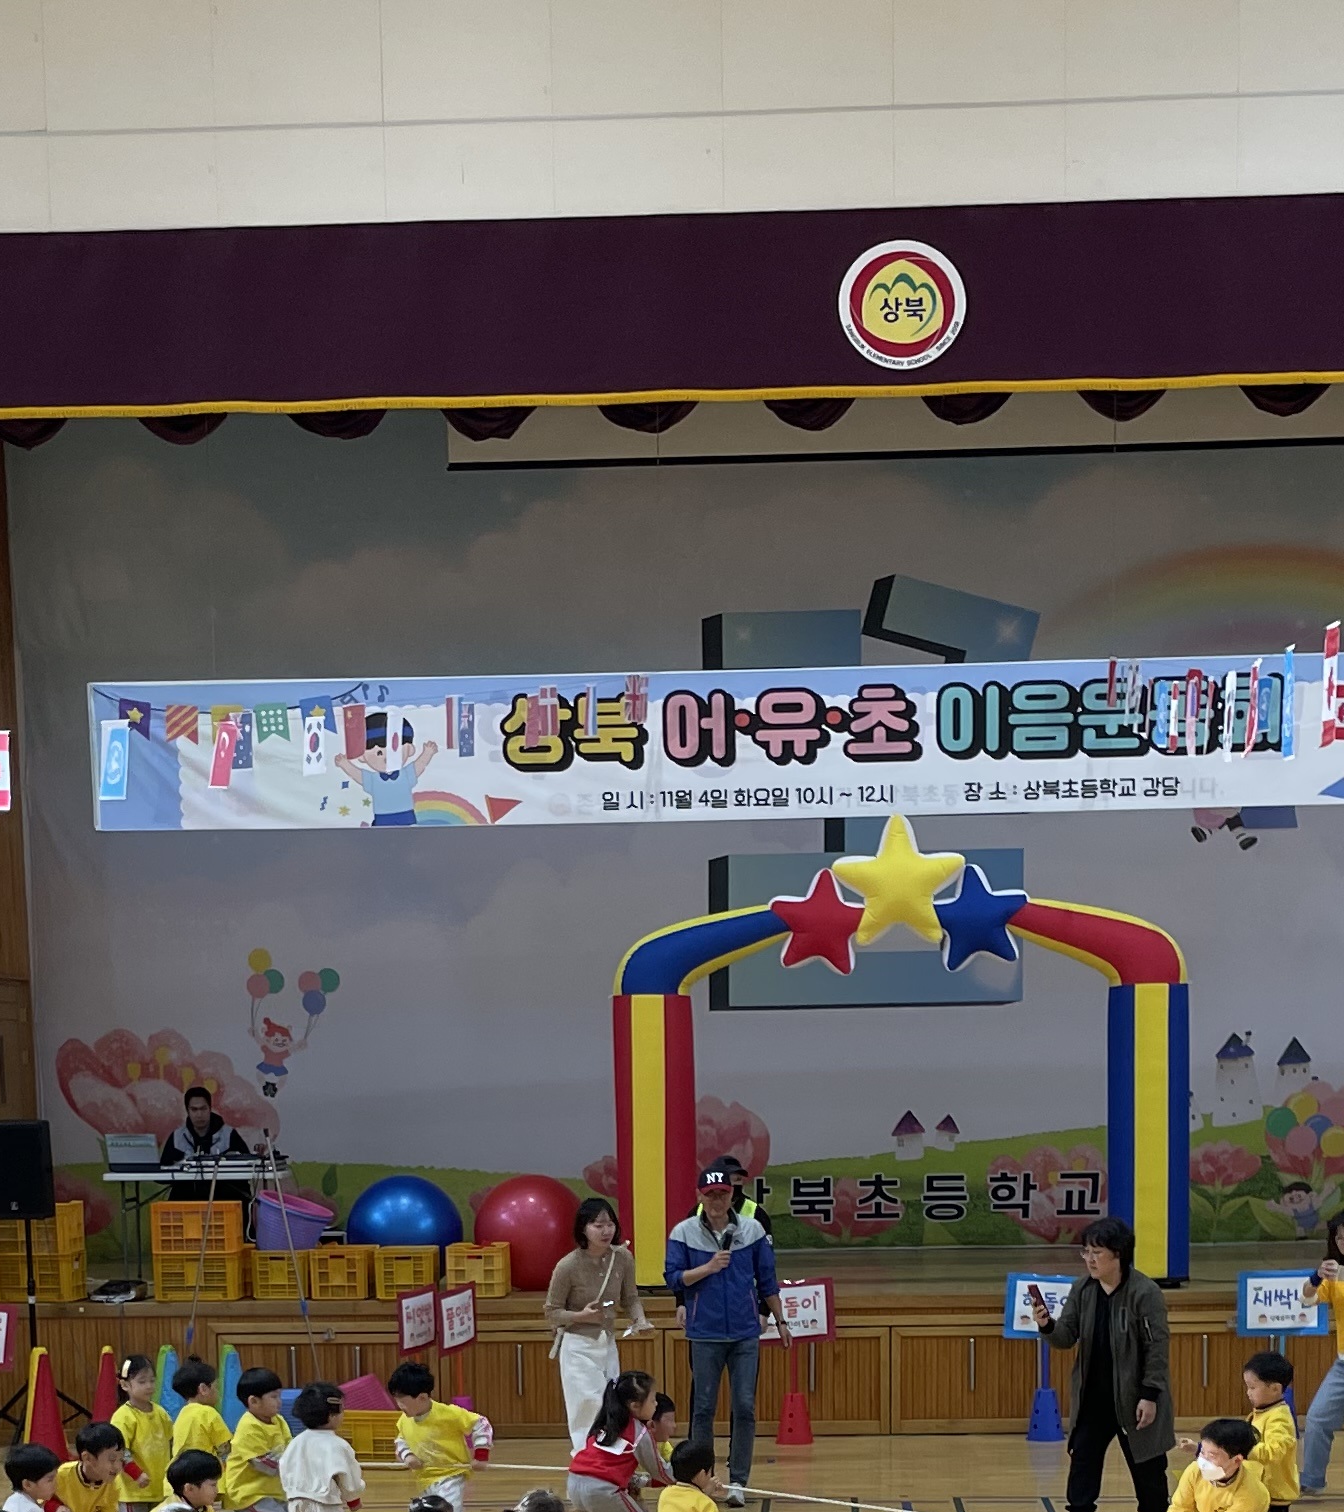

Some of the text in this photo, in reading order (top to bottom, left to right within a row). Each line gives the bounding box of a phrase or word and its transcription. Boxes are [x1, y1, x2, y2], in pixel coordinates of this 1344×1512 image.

[880, 297, 926, 323] 상북
[501, 689, 648, 772] 상북
[602, 791, 621, 810] 일
[660, 789, 692, 809] 11월
[699, 788, 728, 809] 4일
[734, 787, 789, 808] 화요일
[796, 785, 834, 806] 10시
[858, 784, 895, 804] 12시
[964, 782, 984, 801] 장
[1023, 777, 1137, 800] 상북초등학교
[1143, 776, 1181, 797] 강당
[706, 1172, 724, 1184] NY
